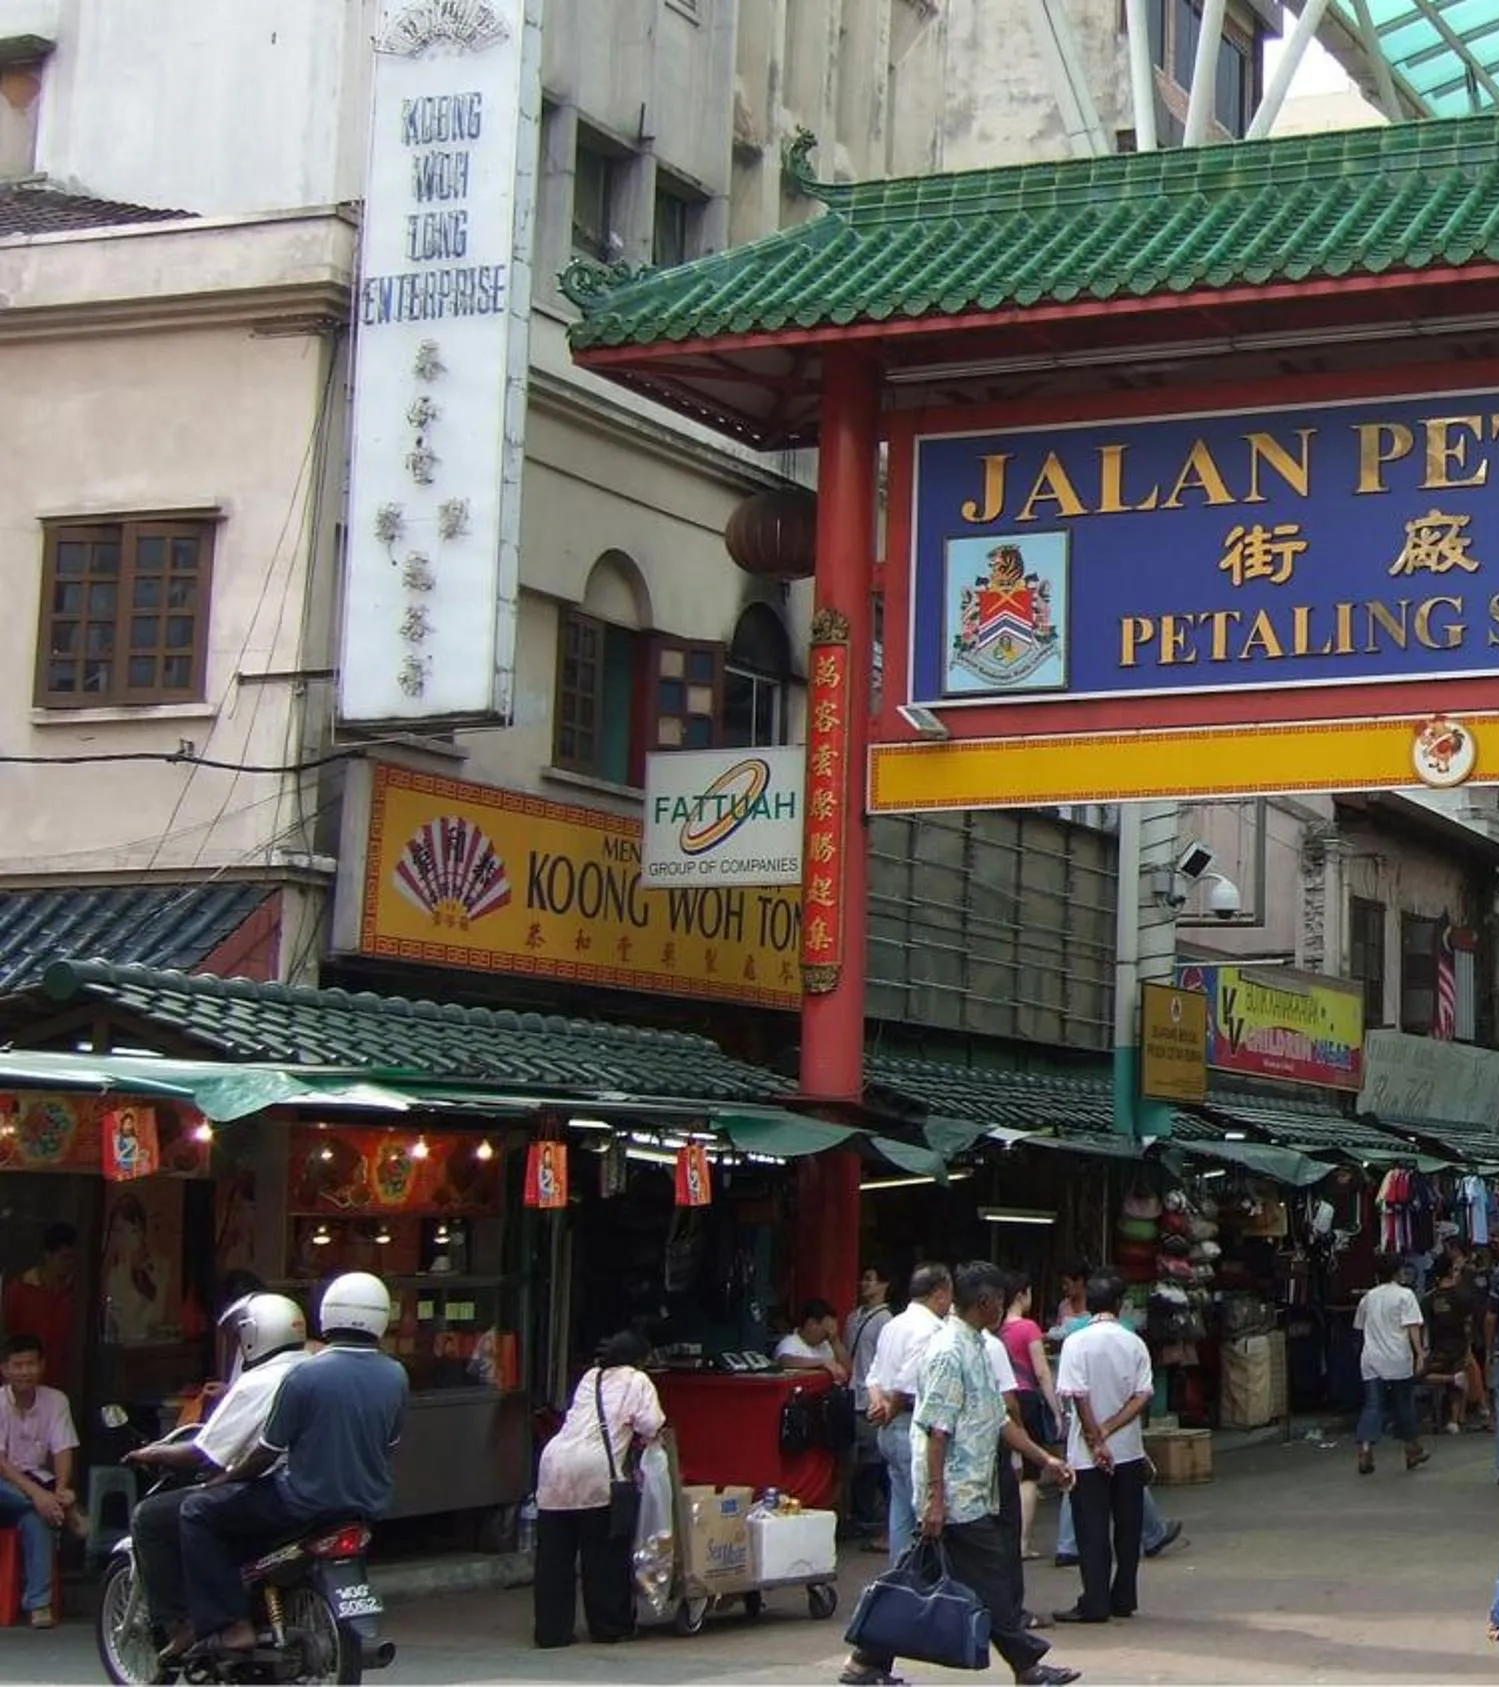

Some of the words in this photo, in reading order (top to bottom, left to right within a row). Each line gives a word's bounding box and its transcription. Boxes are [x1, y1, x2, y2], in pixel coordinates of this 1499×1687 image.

[402, 92, 482, 146] KOONG
[363, 265, 506, 326] ENTERPRISE
[960, 427, 1318, 523] JALAN
[1119, 595, 1467, 667] PETALING
[654, 791, 796, 824] FATTUAH
[527, 850, 650, 929] KOONG
[668, 886, 745, 943] WOH
[648, 860, 697, 877] GROUP
[699, 860, 717, 875] OF
[719, 856, 800, 875] COMPANIES
